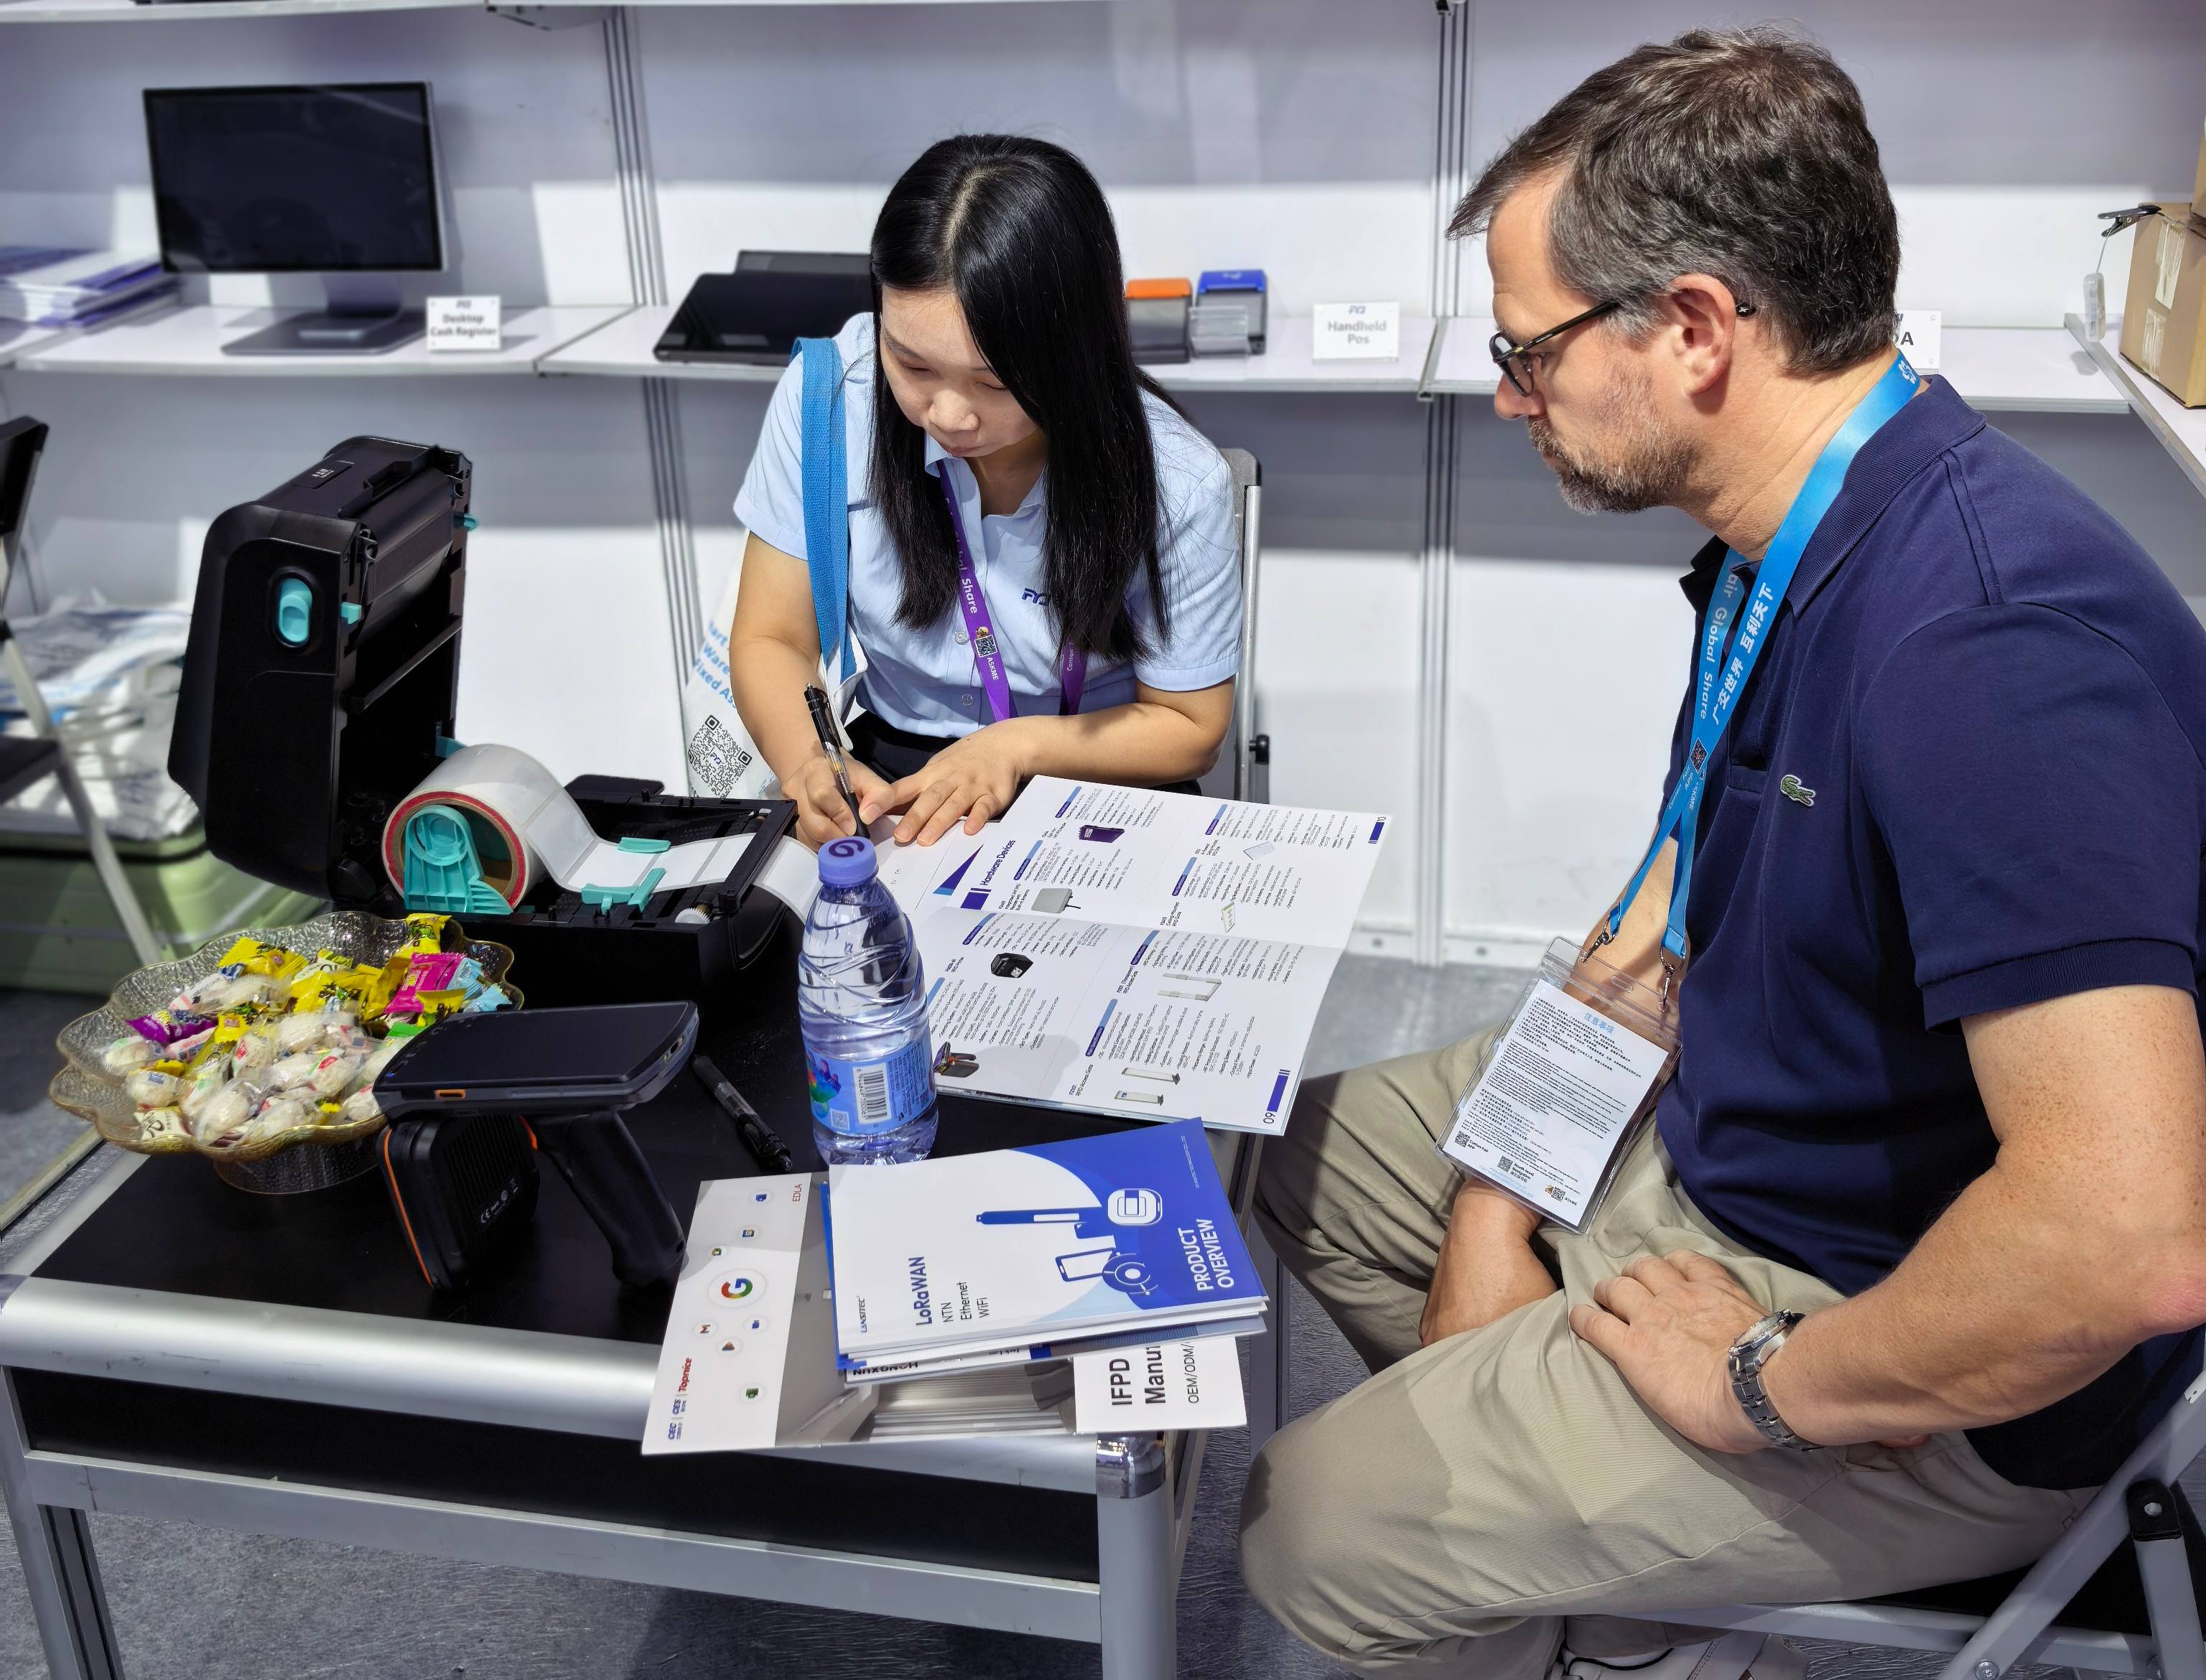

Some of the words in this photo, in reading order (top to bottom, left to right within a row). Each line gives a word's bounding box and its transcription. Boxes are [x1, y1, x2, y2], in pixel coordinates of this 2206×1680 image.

[431, 326, 452, 336] Cash
[456, 326, 496, 340] Register
[442, 314, 484, 325] Desktop
[1327, 320, 1387, 332] Handheld
[1347, 333, 1369, 345] Pos
[962, 578, 977, 614] Share
[1724, 575, 1738, 599] air
[1706, 607, 1727, 663] Global
[987, 657, 999, 681] ASKME
[1712, 656, 1744, 725] 广交世界
[1739, 582, 1774, 654] 互利天下
[1700, 671, 1713, 720] Share
[979, 859, 1004, 885] Hardware
[995, 839, 1016, 859] Devices
[1262, 1112, 1275, 1124] 09
[792, 1183, 802, 1202] EDLA
[1177, 1227, 1214, 1291] PRODUCT
[1196, 1218, 1234, 1288] OVERVIEW
[908, 1256, 933, 1326] LoRaWAN
[956, 1282, 972, 1320] Ethernet
[977, 1297, 990, 1318] WiFi
[941, 1302, 954, 1322] NTN
[1109, 1358, 1132, 1405] IFPD
[1181, 1342, 1199, 1404] OEM/ODM/
